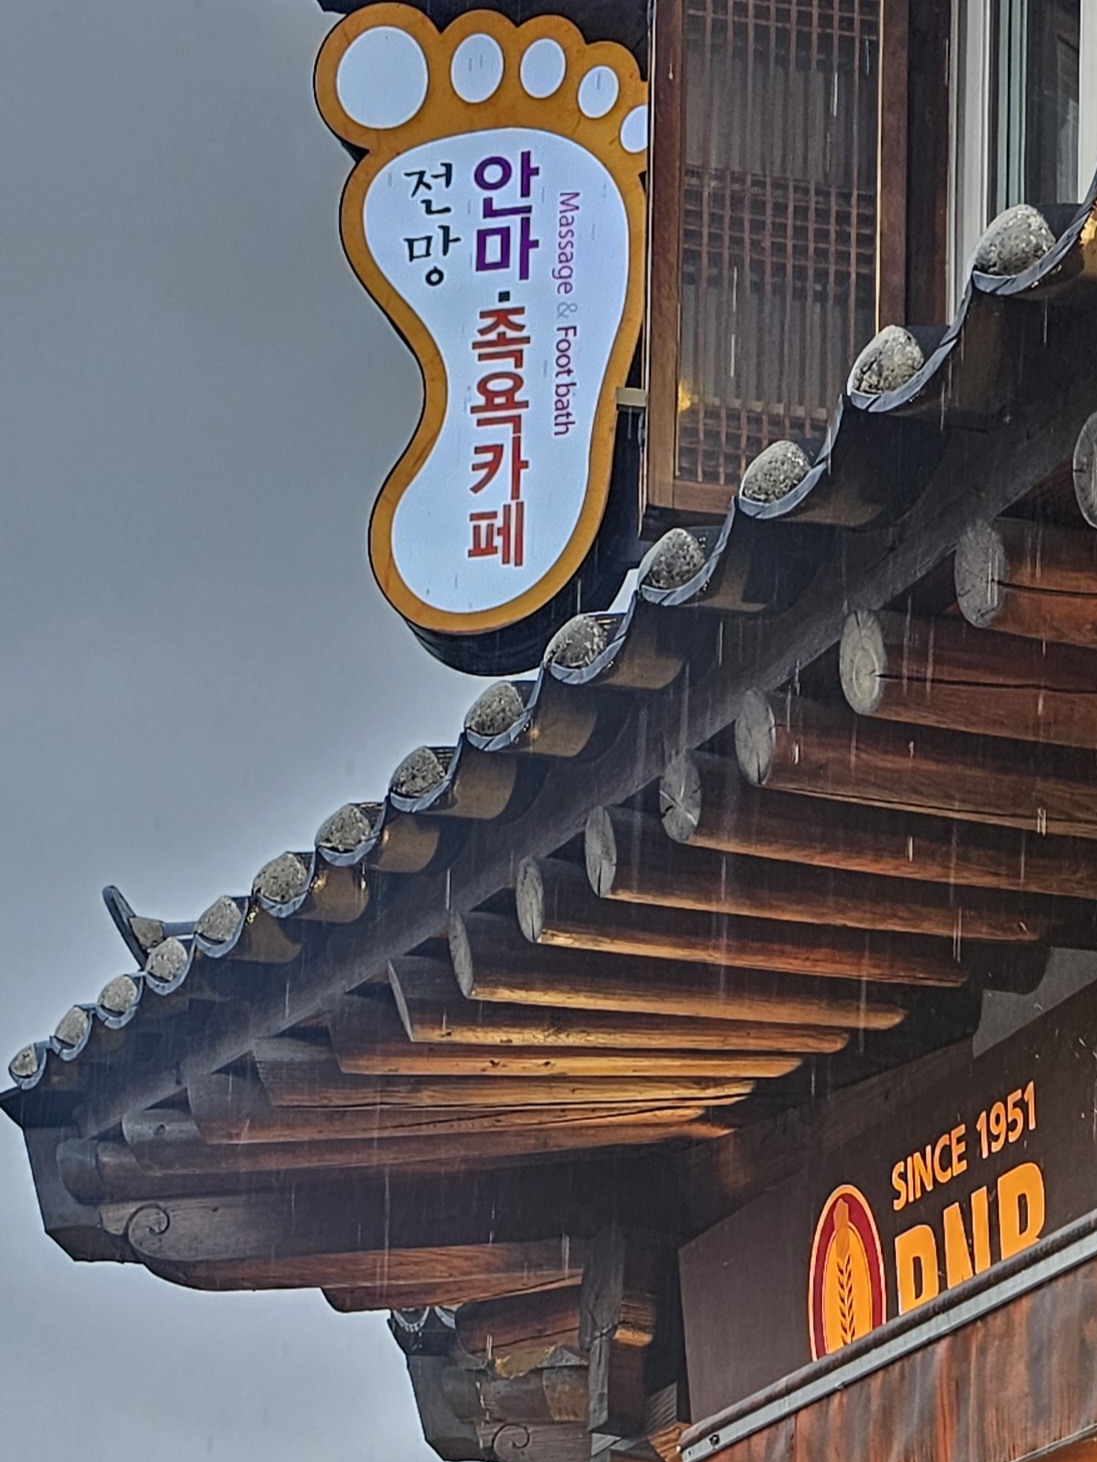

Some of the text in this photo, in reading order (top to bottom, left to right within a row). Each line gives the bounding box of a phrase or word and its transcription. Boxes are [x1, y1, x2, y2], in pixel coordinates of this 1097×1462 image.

[402, 161, 462, 288] 전망
[553, 190, 580, 296] Massage
[891, 1079, 1036, 1212] SINCE 1951
